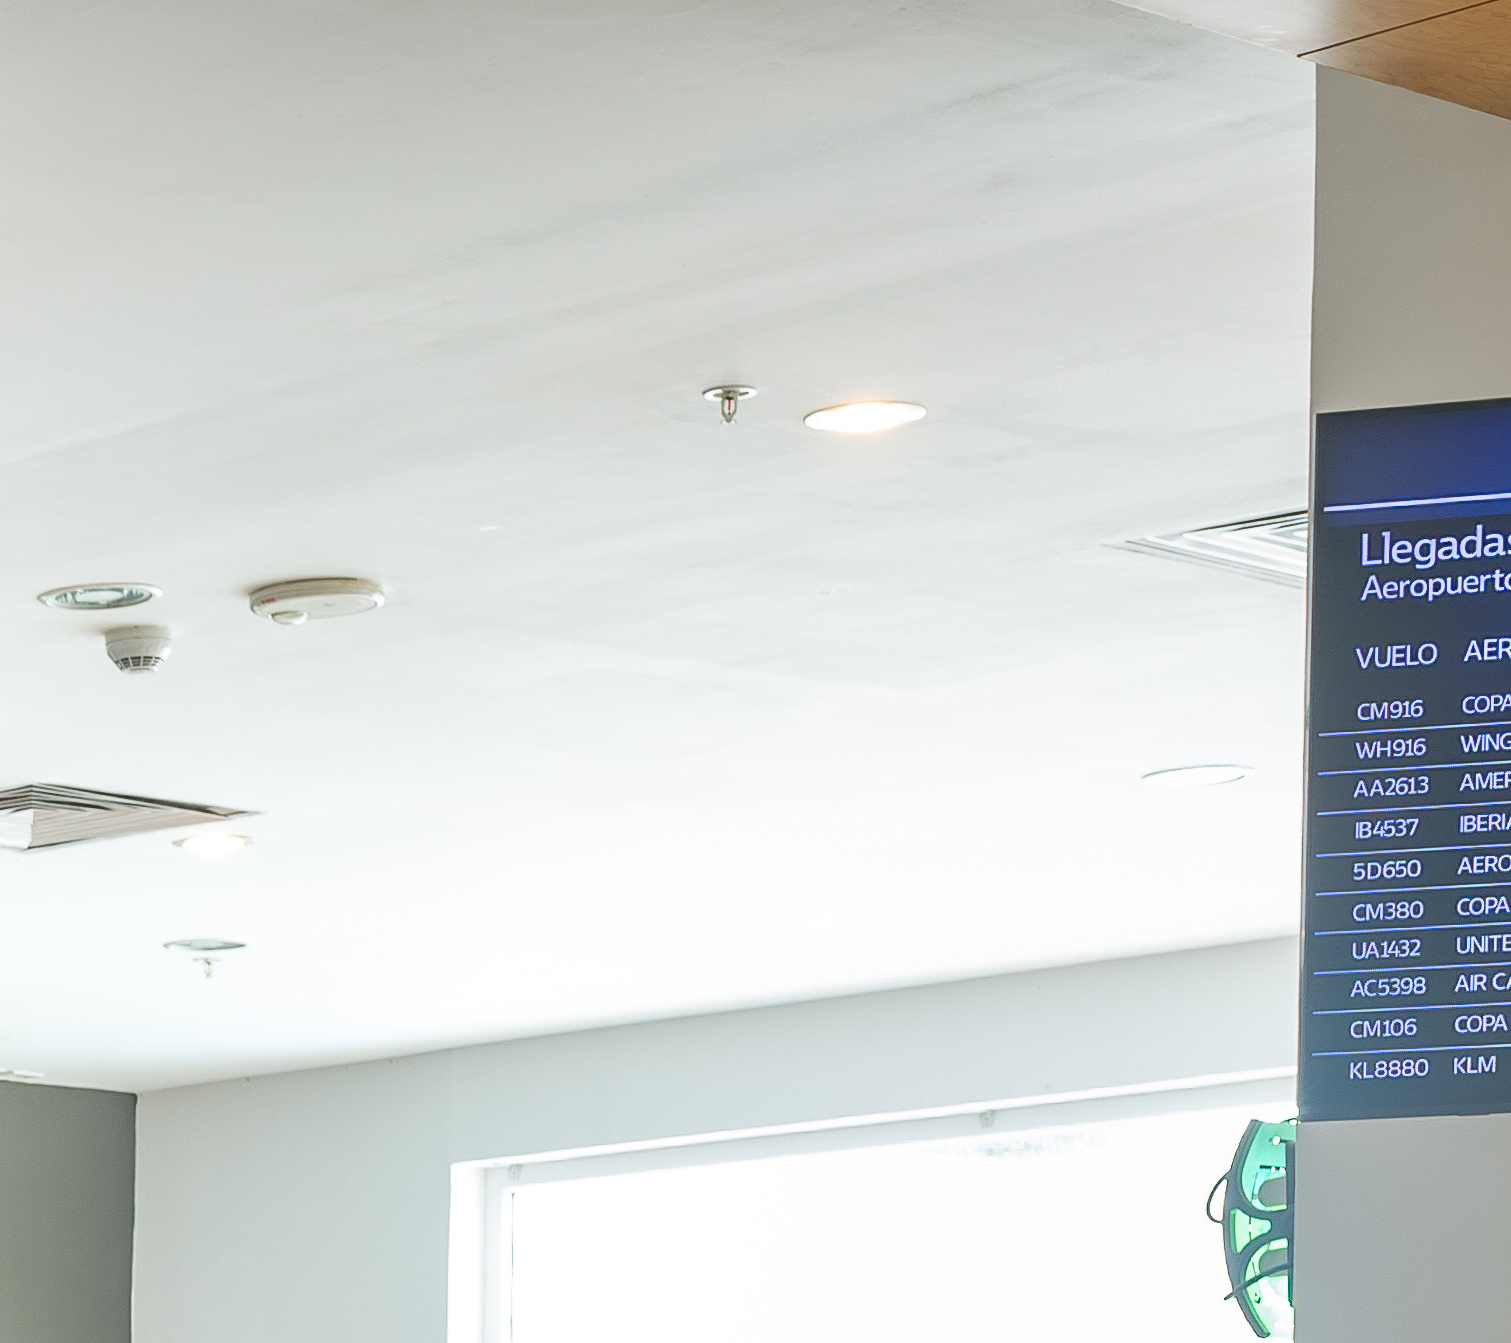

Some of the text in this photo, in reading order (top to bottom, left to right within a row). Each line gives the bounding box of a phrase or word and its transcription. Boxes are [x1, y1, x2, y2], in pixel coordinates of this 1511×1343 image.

[1355, 643, 1438, 669] VUELO
[1356, 700, 1424, 721] CM916
[1355, 738, 1427, 759] WH916
[1353, 776, 1430, 799] AA2613
[1355, 818, 1420, 840] IB4537
[1352, 854, 1511, 881] 5D650 AERO
[1352, 896, 1511, 922] CM380 COPA
[1352, 939, 1421, 960] UA1432
[1350, 977, 1427, 998] AC5398
[1454, 974, 1487, 993] AIR
[1350, 1014, 1508, 1039] CM106 COPA
[1349, 1055, 1497, 1080] KL8880 KLM
